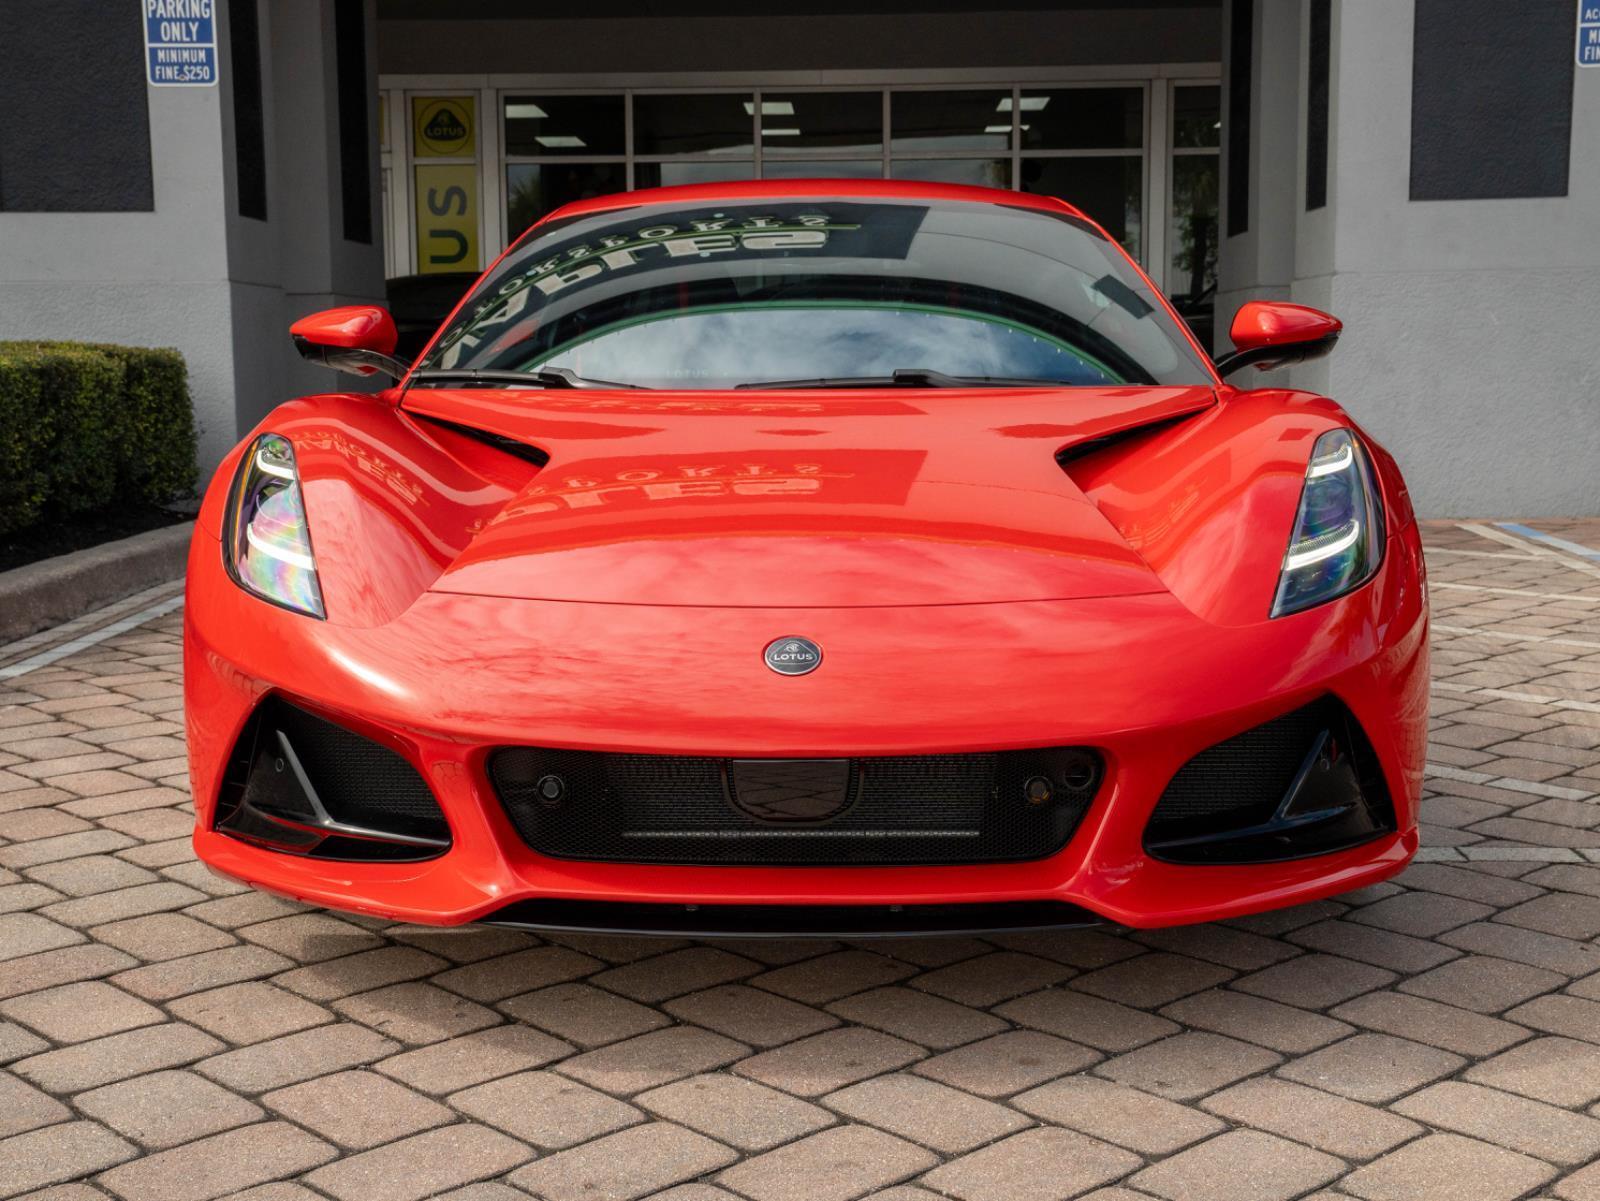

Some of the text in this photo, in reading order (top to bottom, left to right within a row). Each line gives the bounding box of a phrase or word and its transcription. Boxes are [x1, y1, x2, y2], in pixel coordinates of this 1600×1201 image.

[148, 0, 210, 18] PARKING
[1585, 8, 1600, 20] AC
[161, 21, 199, 41] ONLY
[157, 49, 206, 63] MINIMUM
[155, 65, 210, 80] FINE $250
[427, 126, 464, 137] LOTUS
[773, 653, 814, 661] LOTUS
